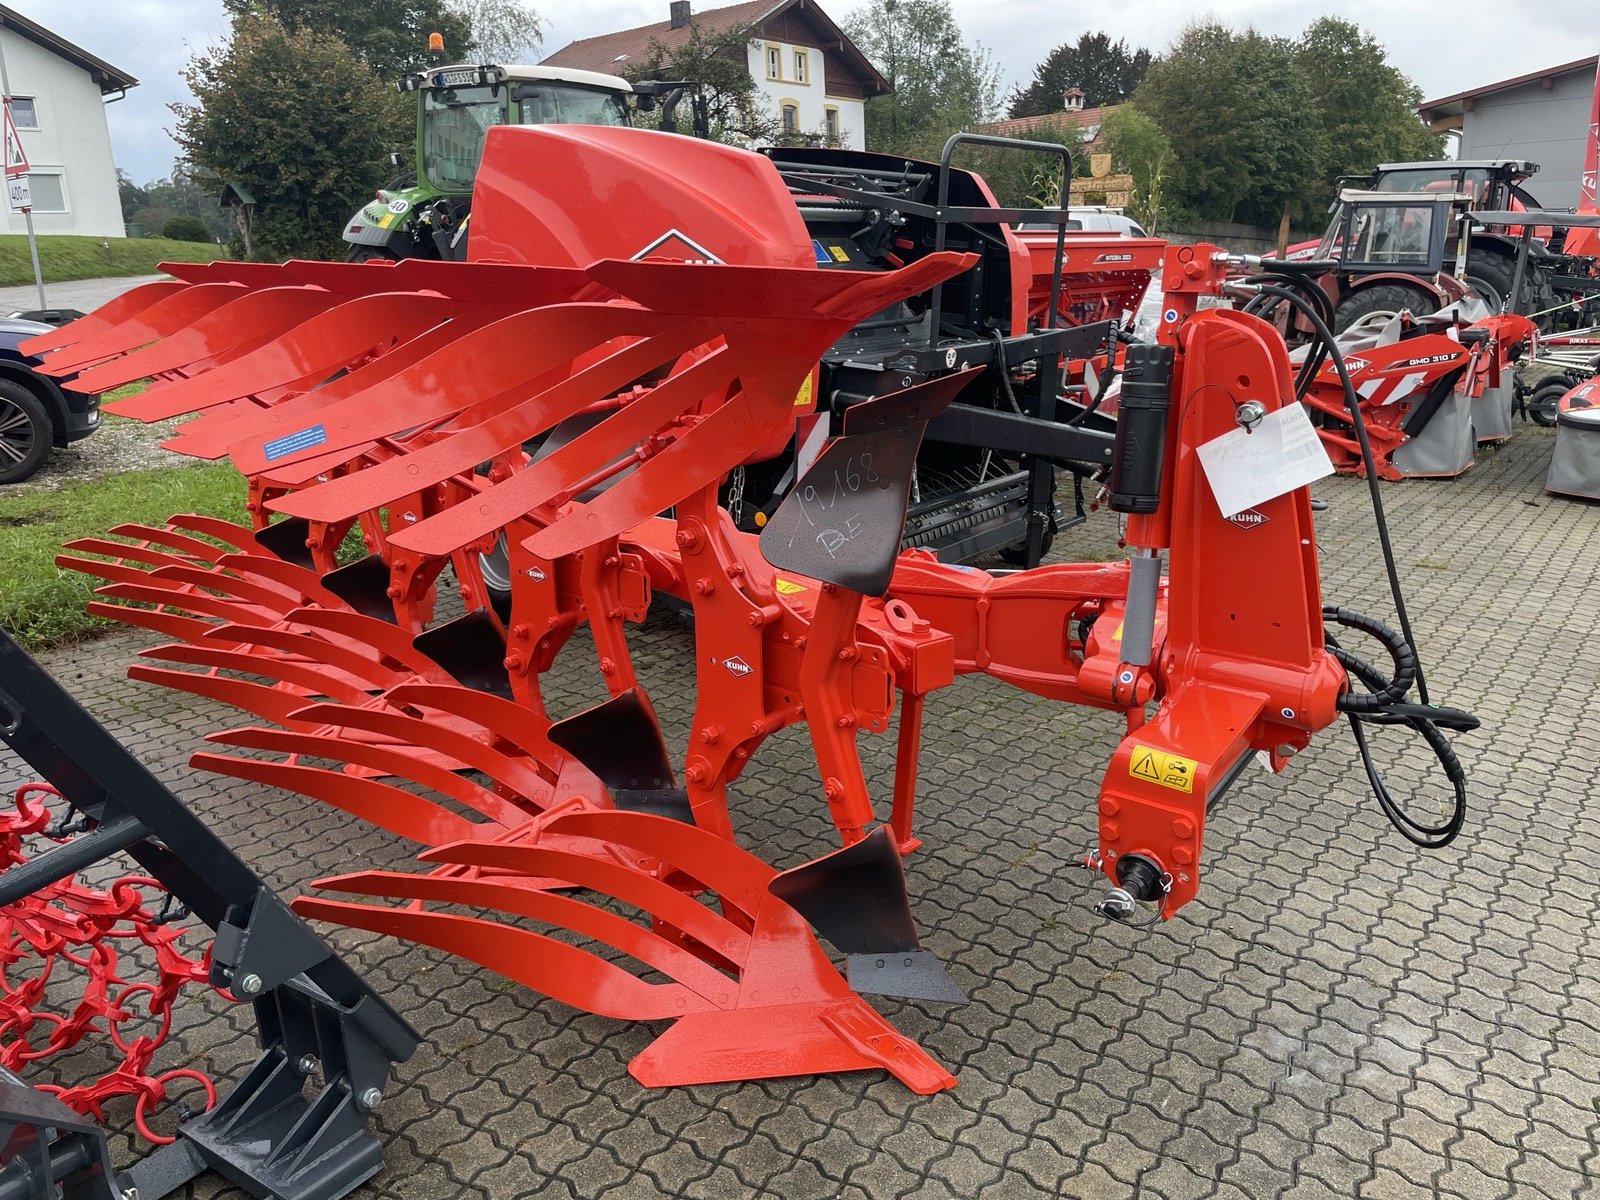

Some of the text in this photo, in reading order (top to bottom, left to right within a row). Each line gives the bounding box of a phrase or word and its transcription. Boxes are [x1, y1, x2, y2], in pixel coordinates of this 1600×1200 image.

[390, 201, 407, 211] 40
[1409, 357, 1430, 366] GMD
[1432, 354, 1448, 362] 310
[1230, 513, 1262, 523] KUHN
[726, 661, 748, 672] KUHN
